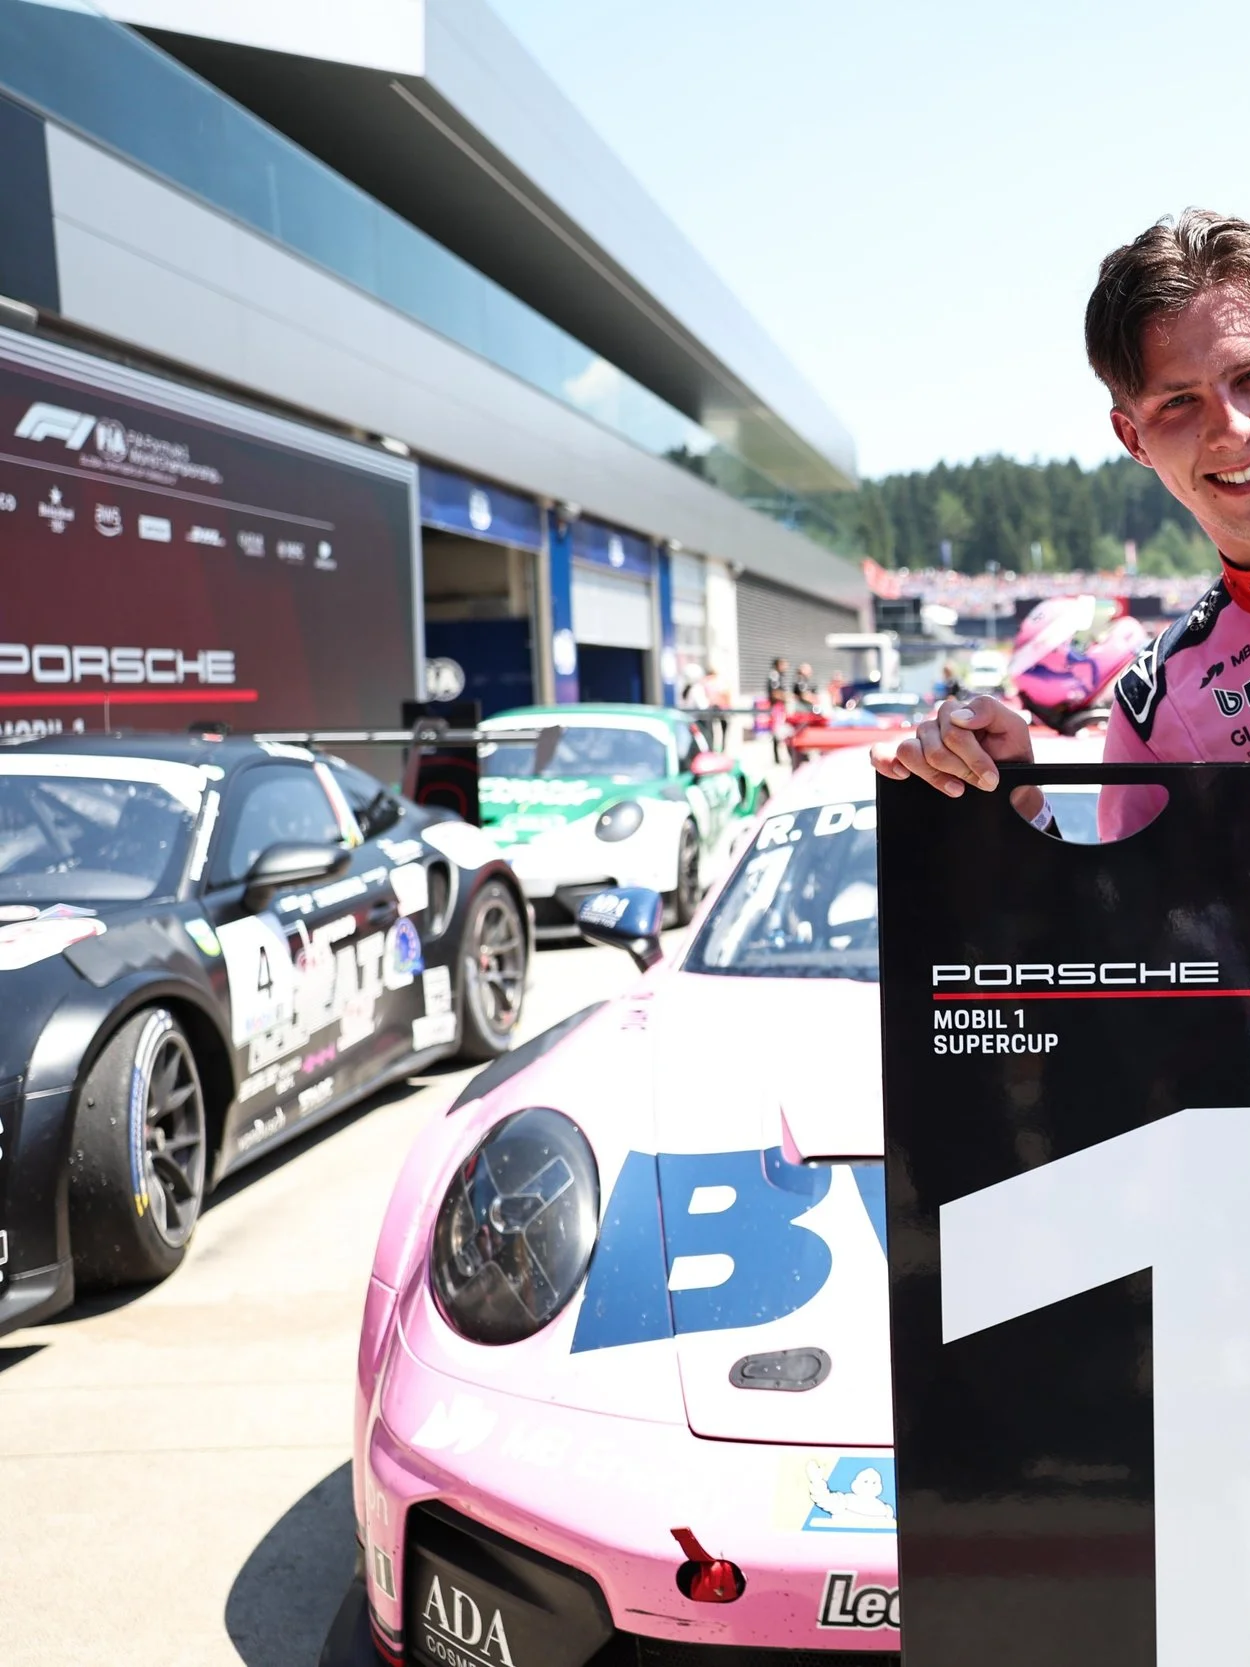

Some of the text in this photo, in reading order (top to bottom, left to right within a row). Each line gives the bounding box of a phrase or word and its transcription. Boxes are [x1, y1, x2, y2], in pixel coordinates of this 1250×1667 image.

[14, 401, 98, 450] F1
[0, 643, 236, 684] PORSCHE
[0, 718, 62, 736] OBIL
[257, 945, 273, 998] 4
[932, 961, 1219, 986] PORSCHE
[933, 1009, 1025, 1030] MOBIL 1
[933, 1033, 1059, 1055] SUPERCUP
[421, 1574, 517, 1667] ADA
